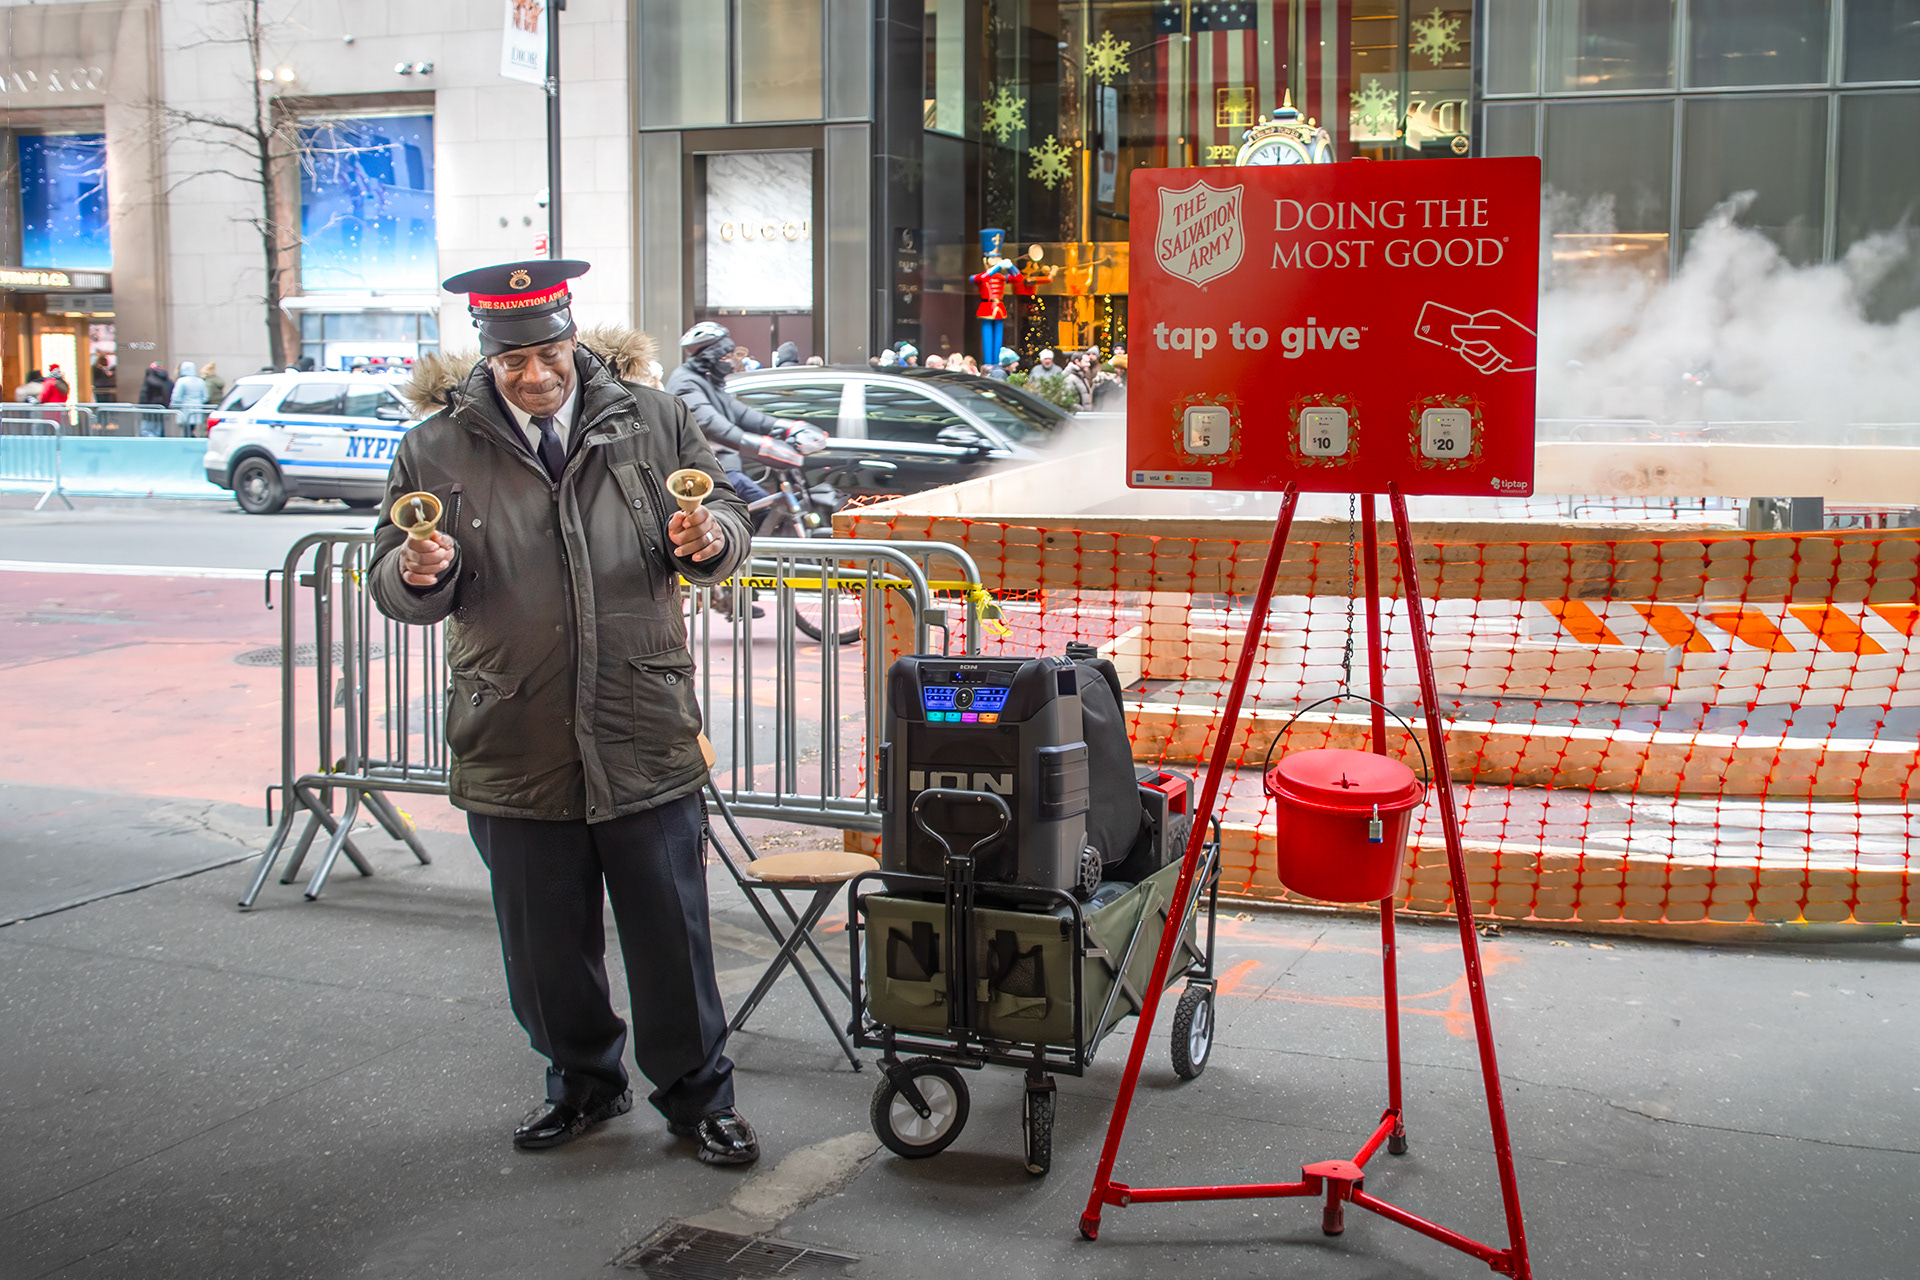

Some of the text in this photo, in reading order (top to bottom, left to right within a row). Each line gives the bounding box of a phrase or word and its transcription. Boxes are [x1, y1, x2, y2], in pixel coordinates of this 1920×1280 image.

[1173, 191, 1208, 227] THE
[1273, 198, 1489, 232] DOING THE
[720, 221, 810, 241] GUCCI
[1161, 195, 1236, 261] SALVATION
[1187, 226, 1234, 275] ARMY
[1270, 240, 1374, 269] MOST
[478, 288, 565, 310] THE SALVATION ARMY
[1153, 321, 1218, 359] tap
[1228, 320, 1269, 350] to
[1198, 435, 1211, 447] $5
[1312, 437, 1332, 449] $10
[1432, 438, 1455, 451] $20
[1501, 479, 1528, 490] tiptap
[909, 770, 1014, 796] ION
